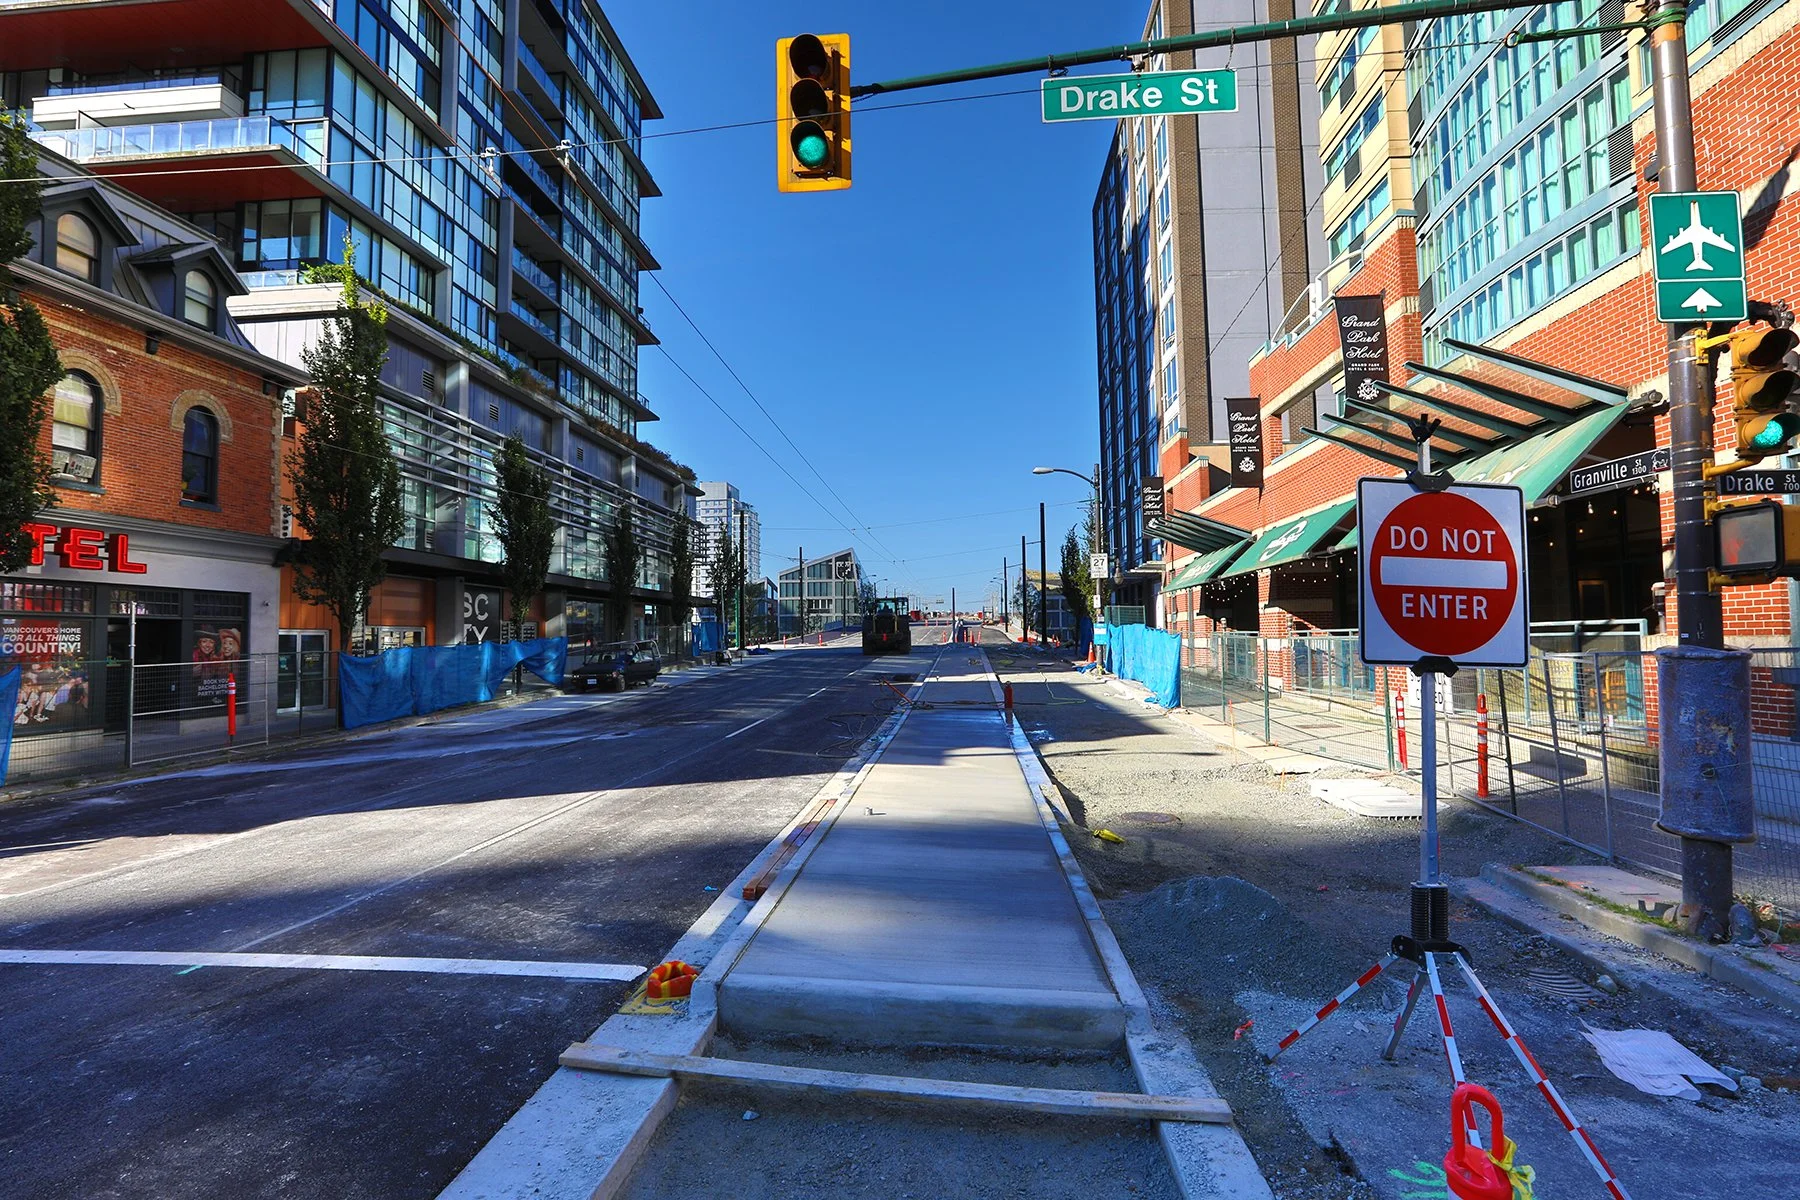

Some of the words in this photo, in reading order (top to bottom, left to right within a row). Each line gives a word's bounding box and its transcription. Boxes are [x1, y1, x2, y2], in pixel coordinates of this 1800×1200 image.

[1061, 82, 1162, 112] Drake
[1180, 76, 1219, 106] St
[1342, 315, 1380, 327] Grand
[1347, 330, 1380, 342] Park
[1345, 346, 1384, 359] Hotel
[1229, 411, 1258, 422] Grand
[1232, 423, 1258, 433] Park
[1231, 434, 1260, 444] Hotel
[1573, 463, 1628, 489] Granville
[1634, 458, 1642, 467] St
[1632, 465, 1647, 475] 1300
[1726, 473, 1775, 492] Drake
[1785, 474, 1796, 483] St
[1783, 482, 1800, 491] 700
[1390, 525, 1428, 551] DO
[1442, 528, 1496, 554] NOT
[19, 522, 147, 574] TEL
[1093, 558, 1105, 567] 27
[1402, 593, 1488, 620] ENTER
[2, 626, 59, 634] VANCOUVER'S
[2, 634, 23, 642] FOR
[24, 634, 44, 642] ALL
[46, 634, 82, 642] THINGS
[2, 642, 82, 654] COUNTRY!
